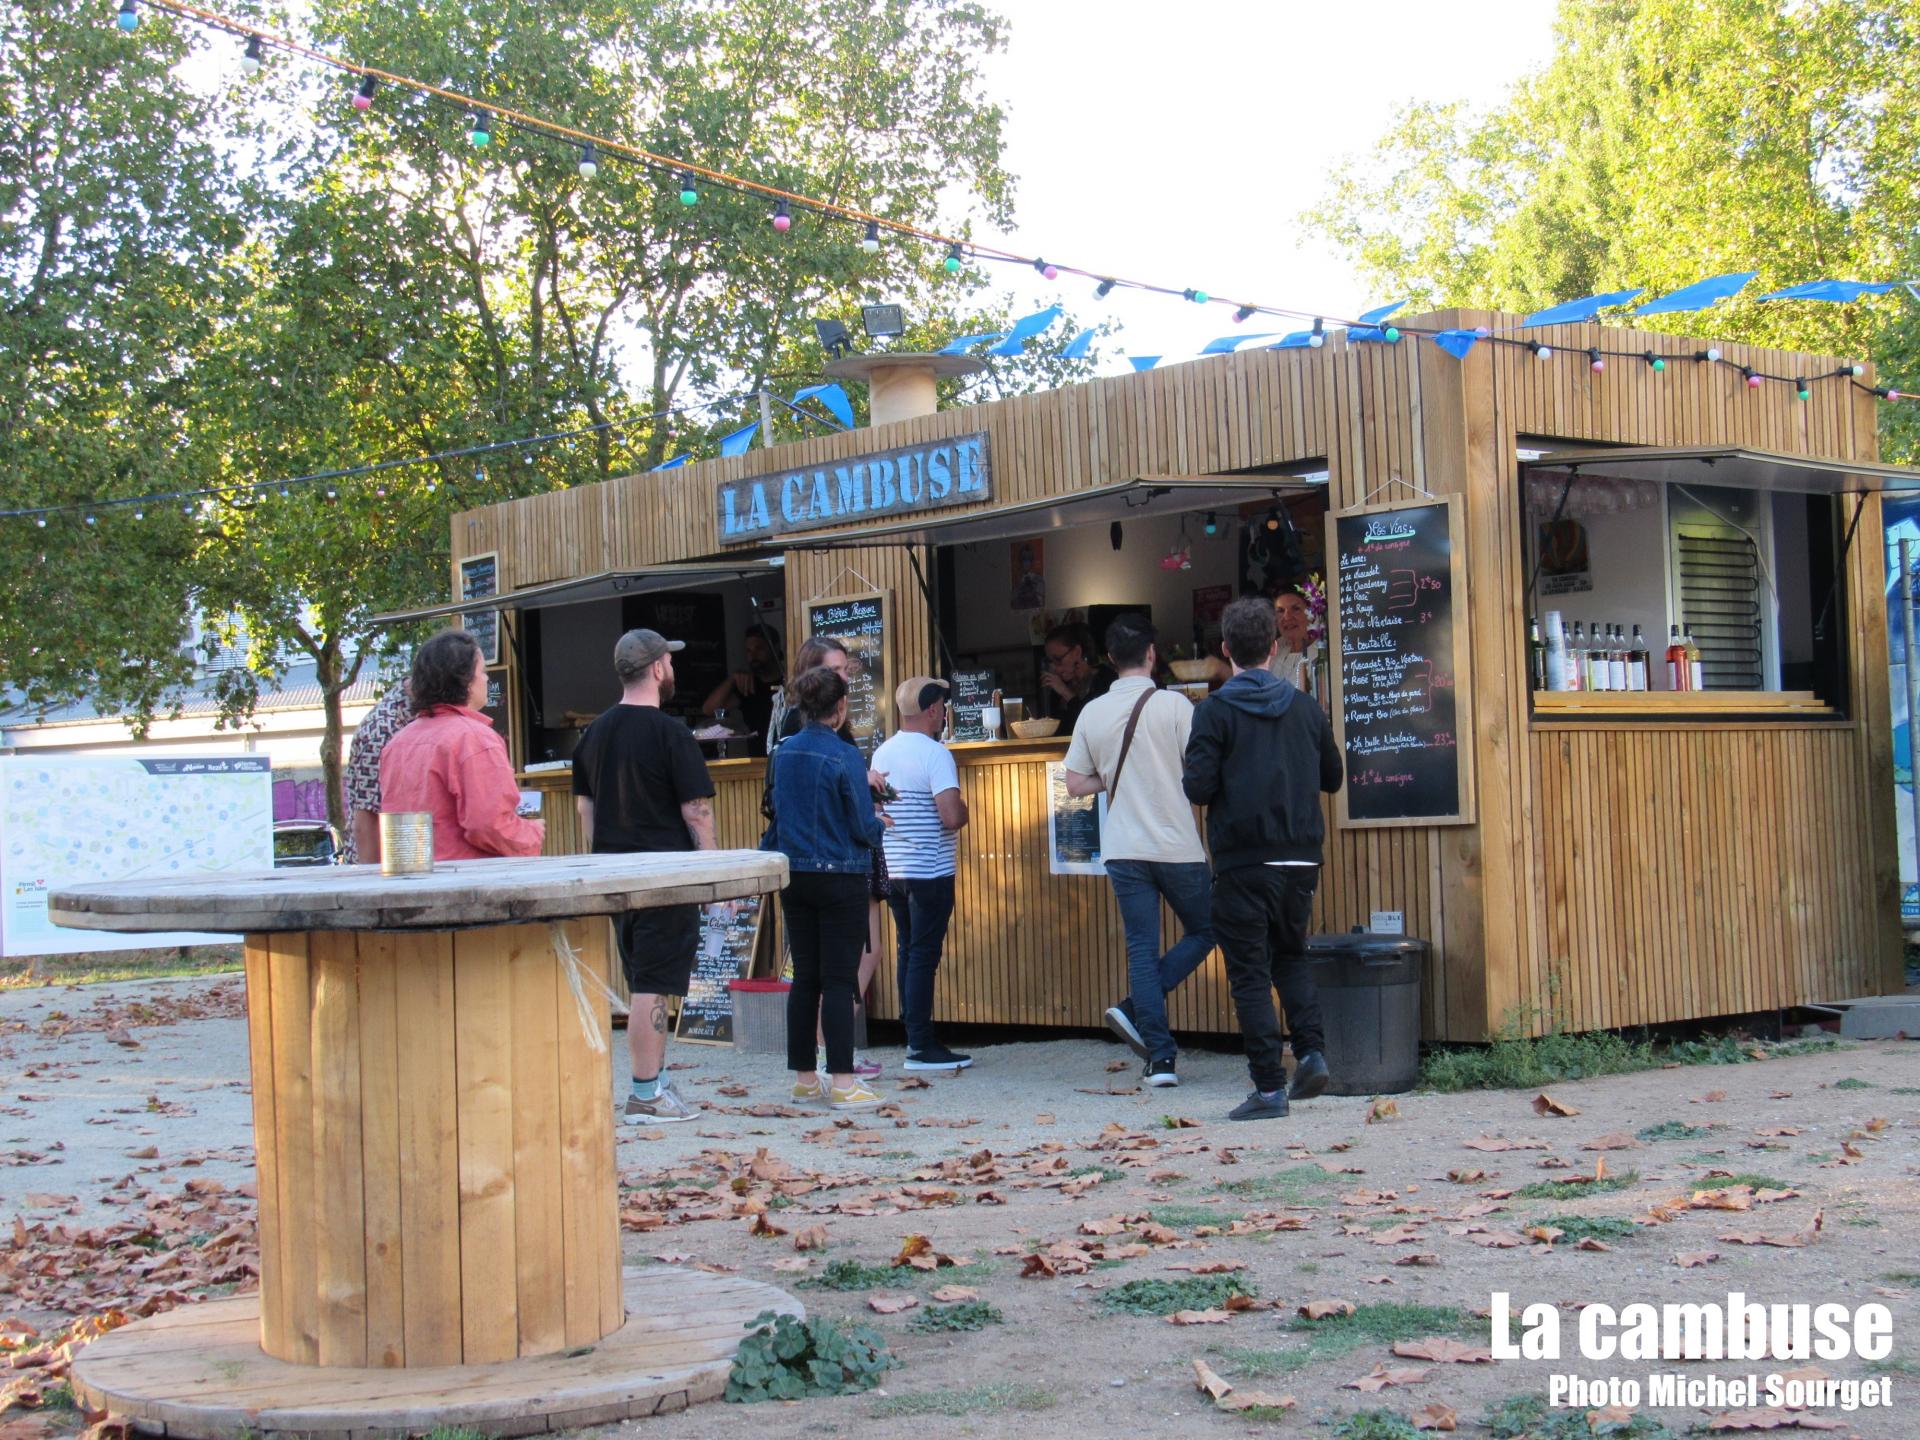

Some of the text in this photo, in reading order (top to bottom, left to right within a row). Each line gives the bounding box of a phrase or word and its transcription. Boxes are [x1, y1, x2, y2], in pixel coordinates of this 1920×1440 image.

[723, 438, 982, 535] LA CAMBUSE
[1366, 521, 1386, 536] Nos
[1356, 604, 1374, 616] Rouge
[1348, 618, 1365, 630] Bulle
[1351, 710, 1373, 724] Rouge
[1385, 773, 1414, 787] consigne
